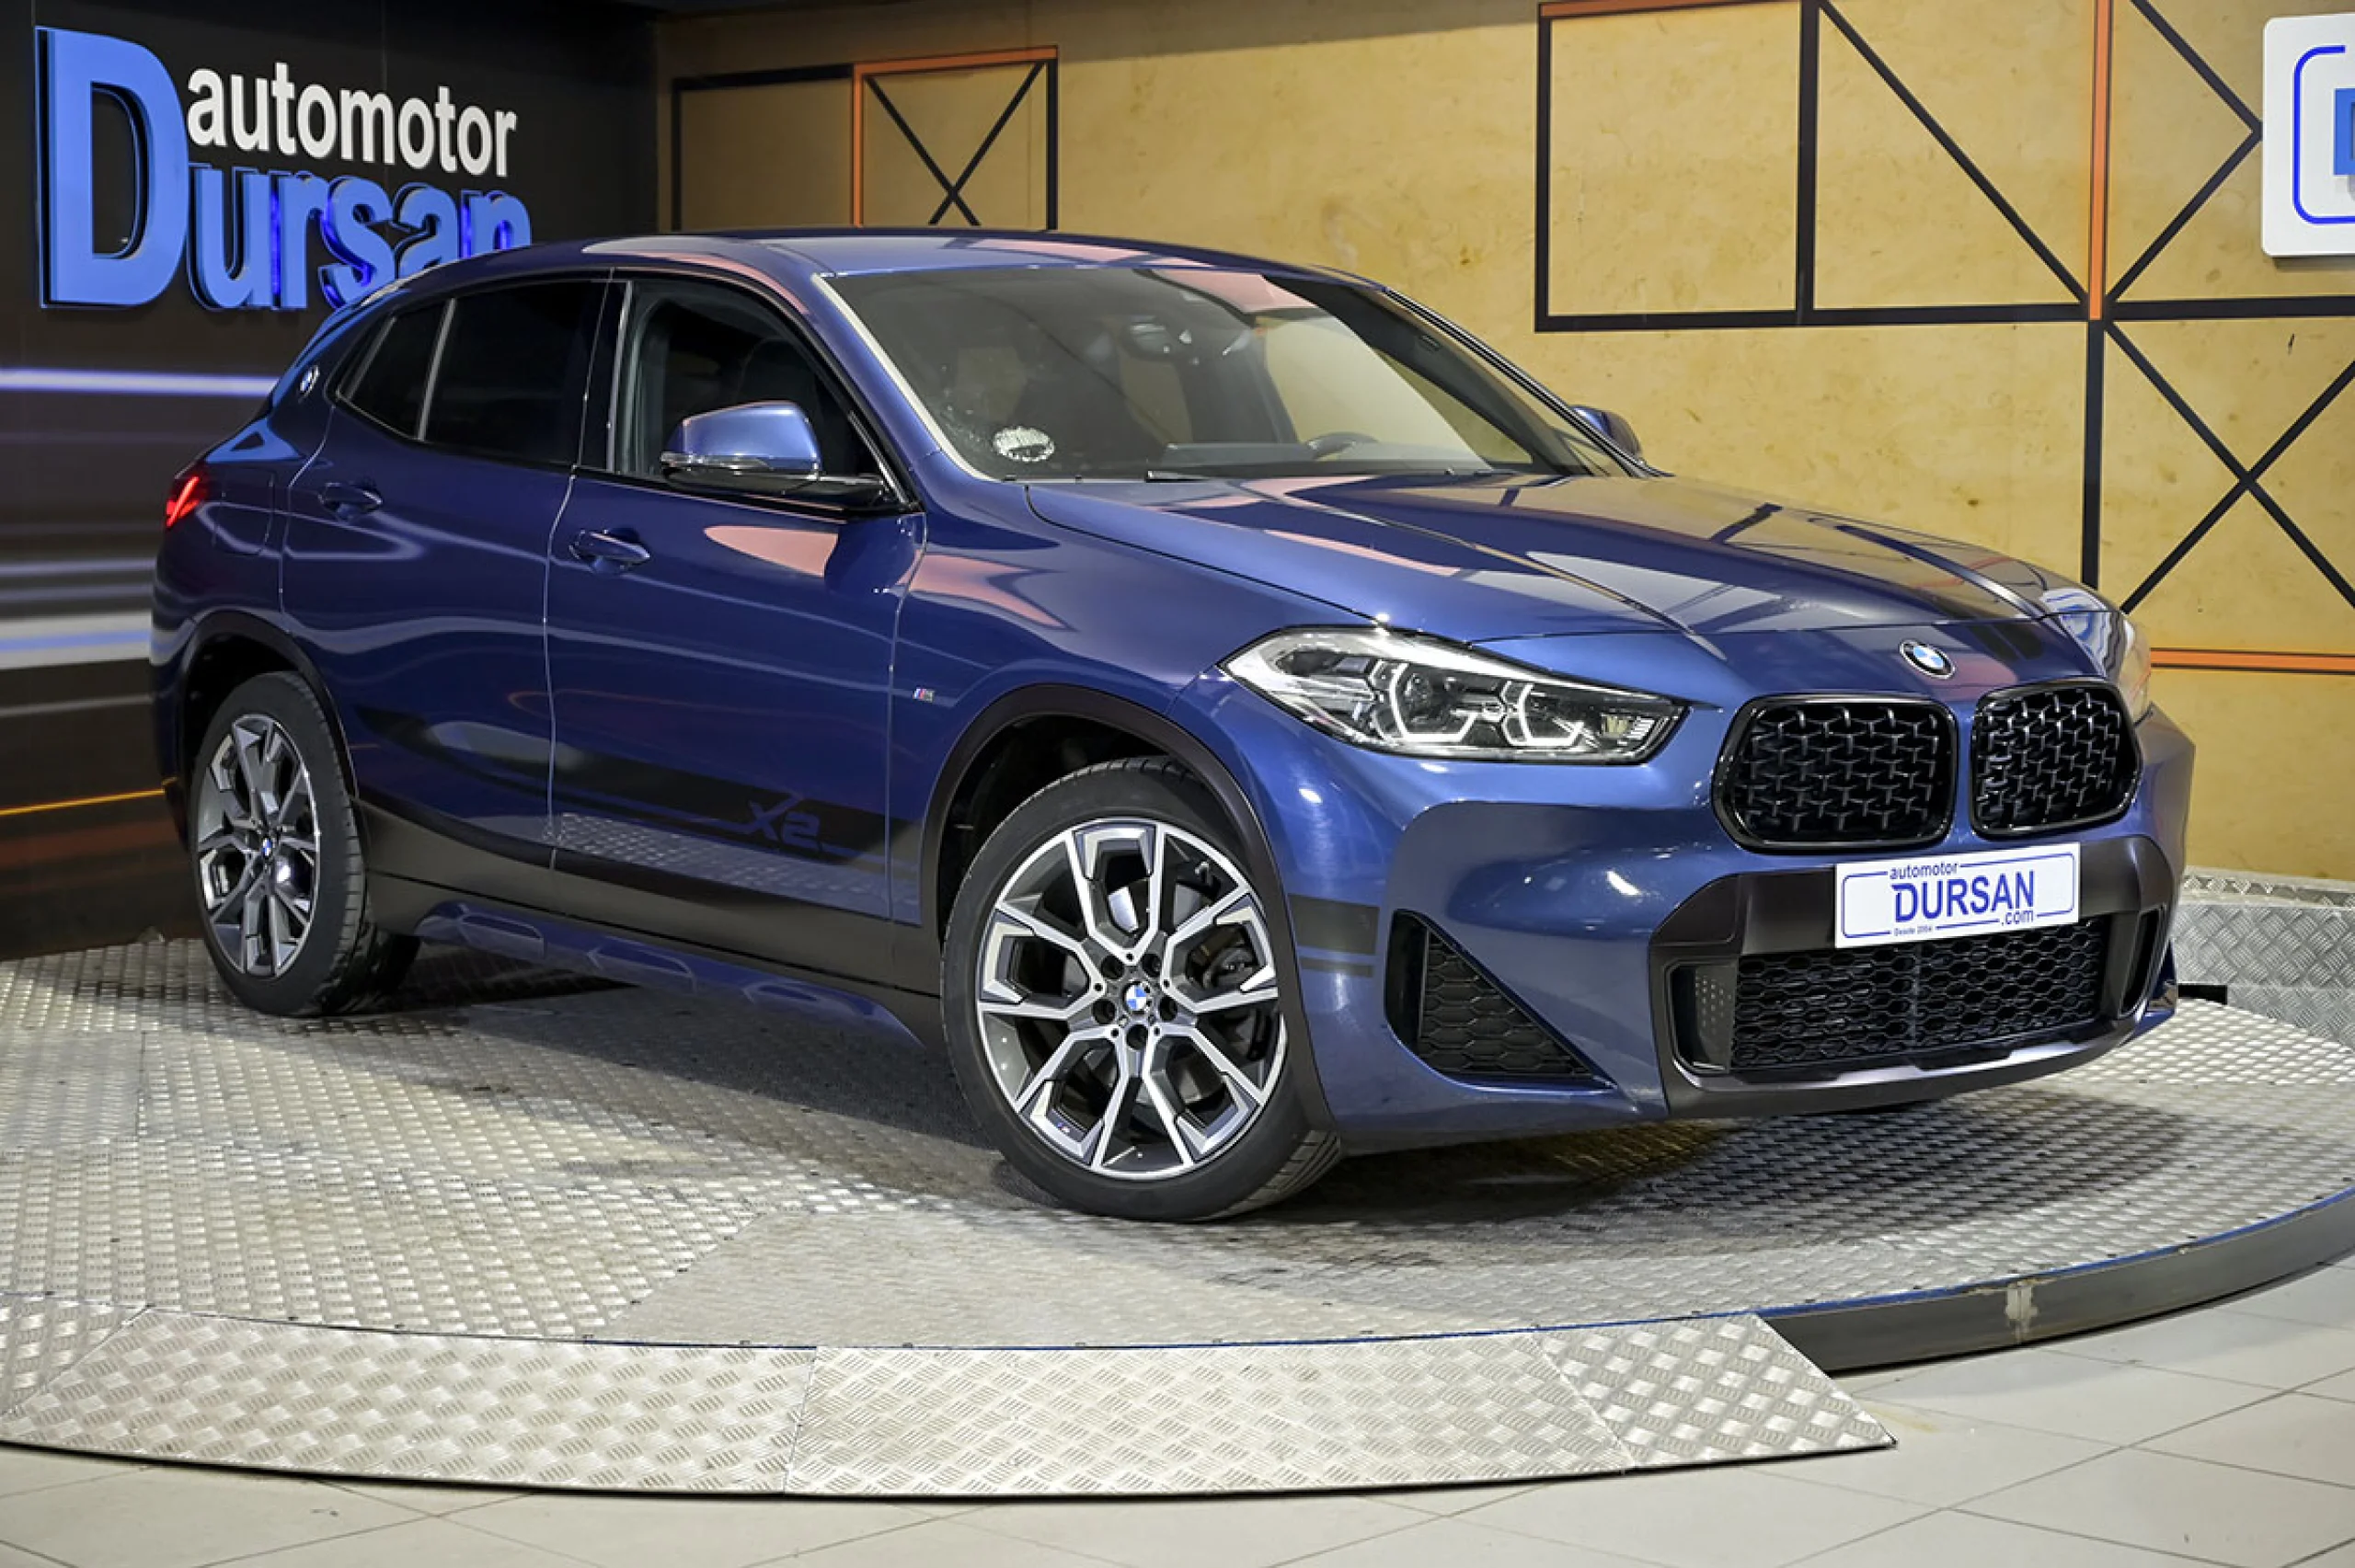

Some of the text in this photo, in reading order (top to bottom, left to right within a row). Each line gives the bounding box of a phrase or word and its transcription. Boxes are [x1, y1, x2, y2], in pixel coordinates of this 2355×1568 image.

[187, 62, 517, 177] automotor
[1890, 862, 1959, 880] automotor
[1891, 870, 2035, 923] DURSAN
[2000, 908, 2035, 926] .com
